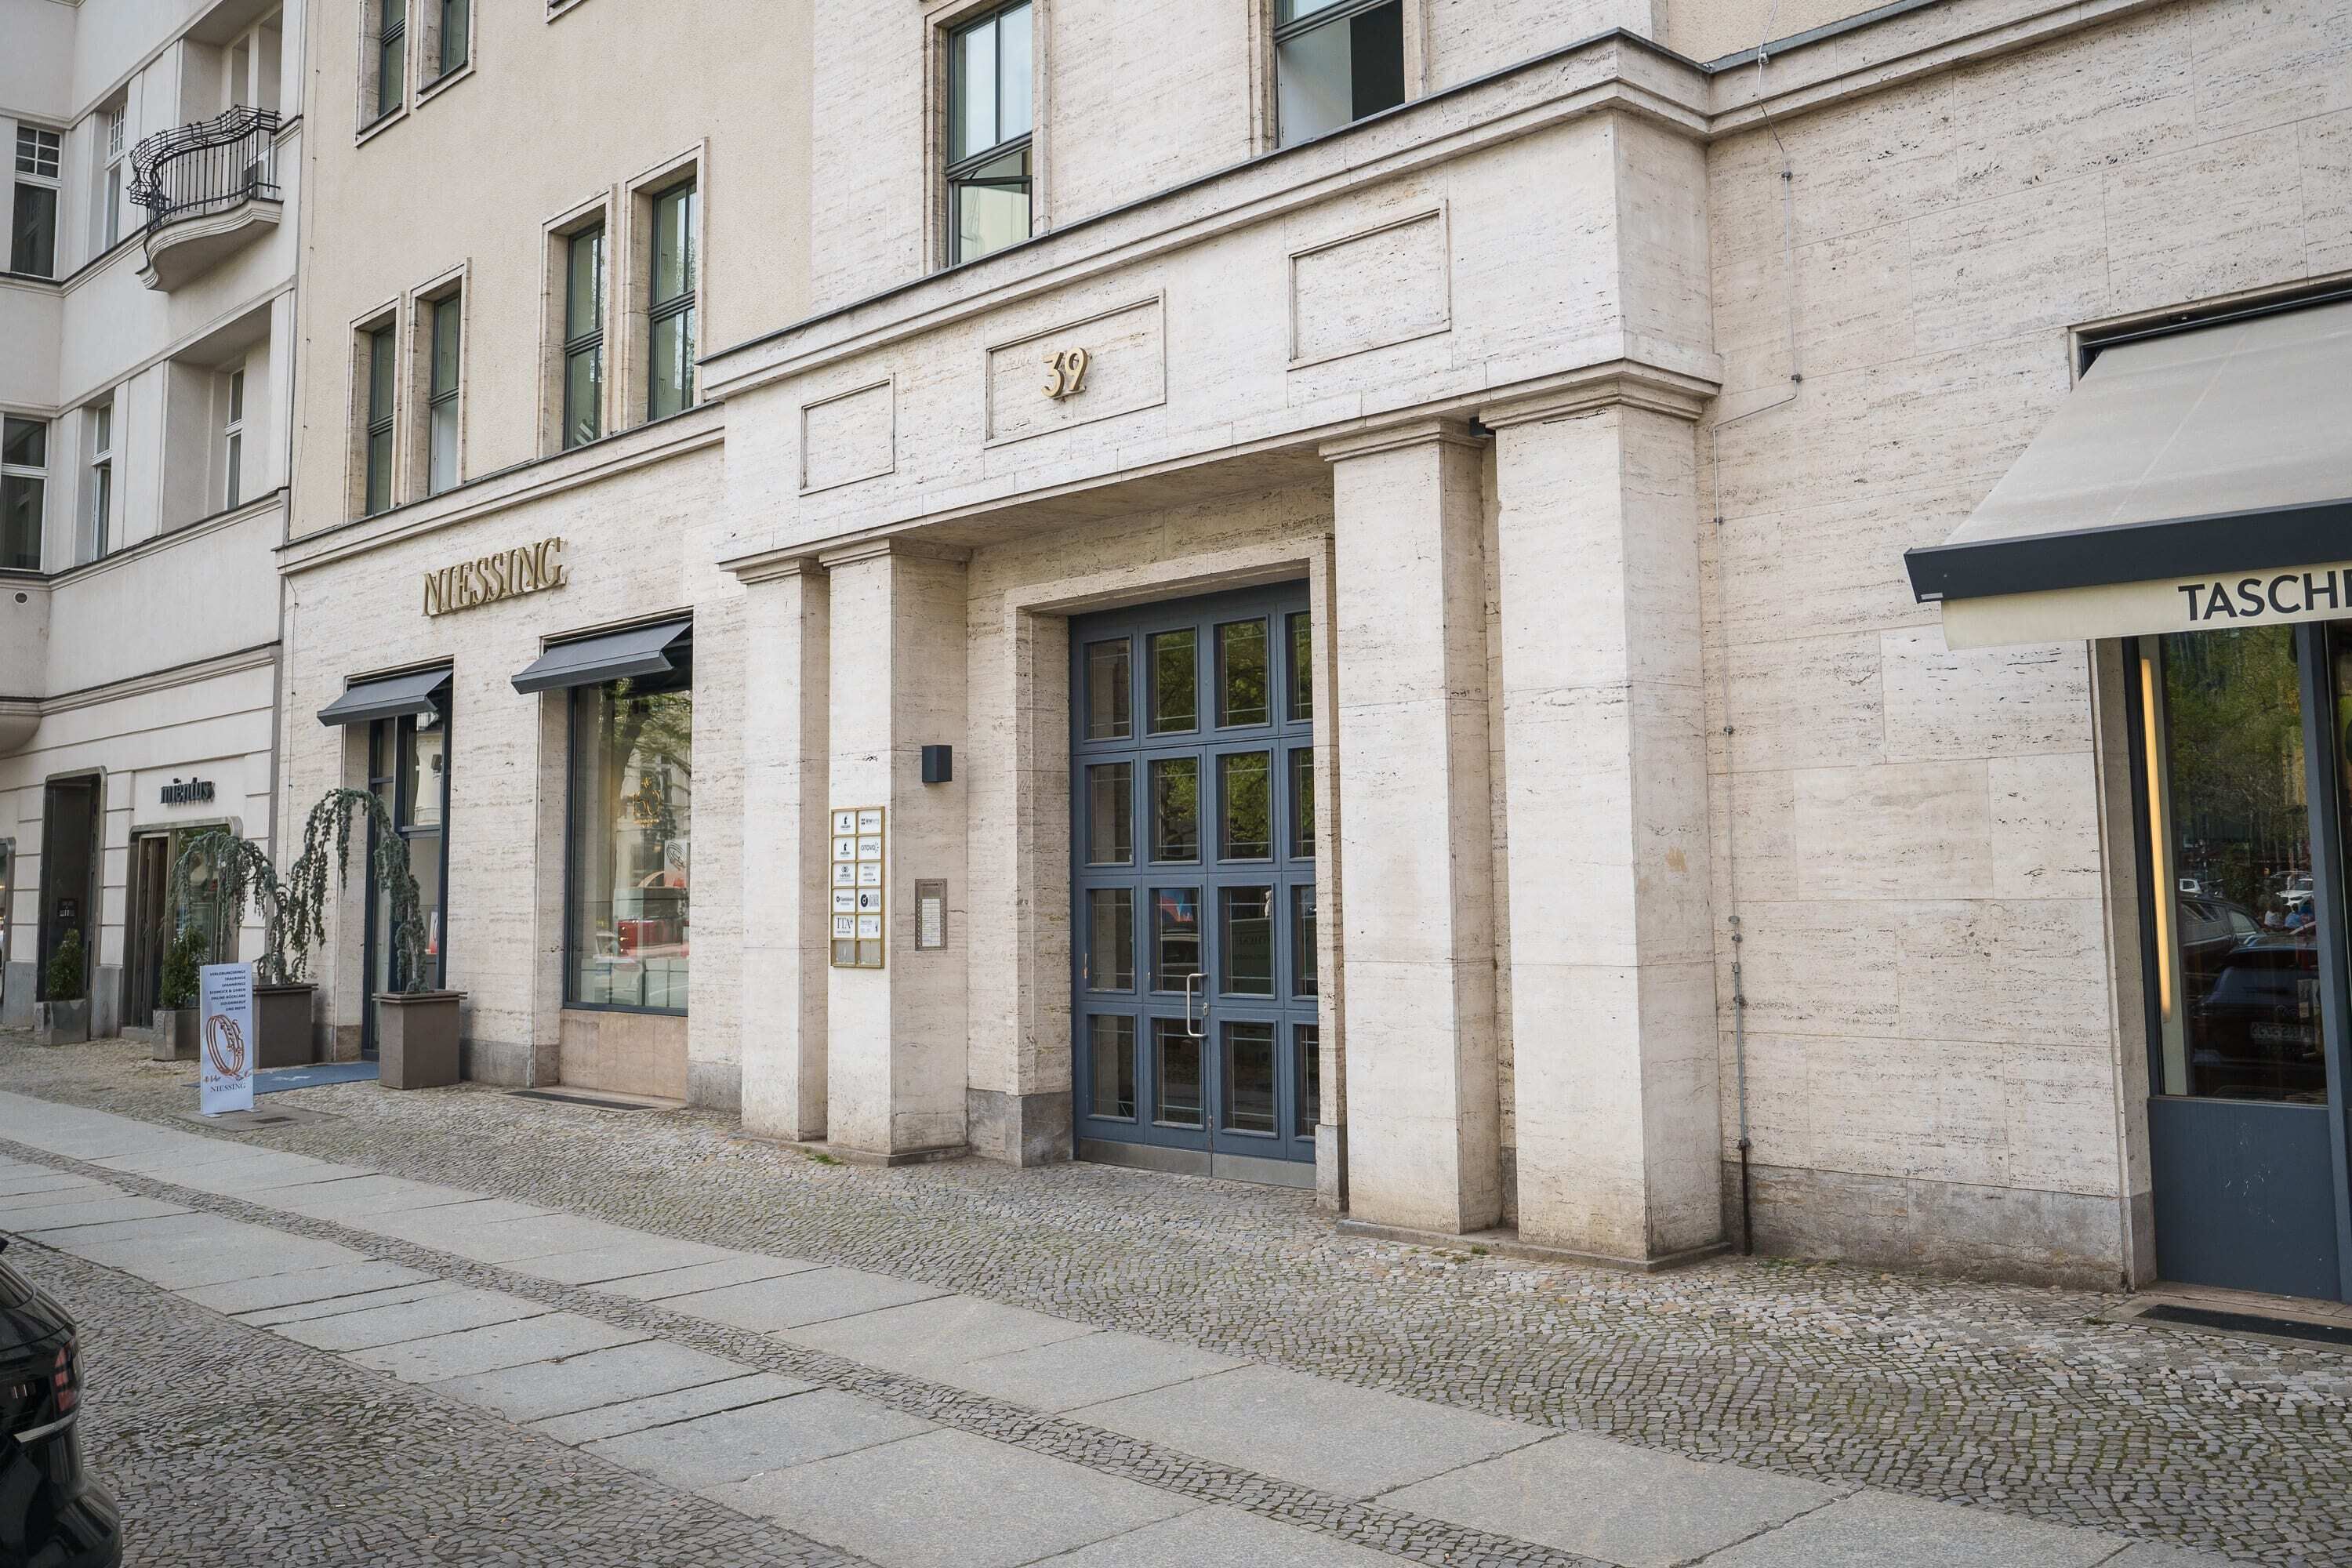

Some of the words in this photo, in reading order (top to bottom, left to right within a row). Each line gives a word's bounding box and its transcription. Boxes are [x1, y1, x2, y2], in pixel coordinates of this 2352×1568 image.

[1041, 347, 1088, 398] 39
[421, 536, 565, 617] NIESSING
[160, 777, 216, 804] mientus
[210, 1082, 246, 1093] NIESSING
